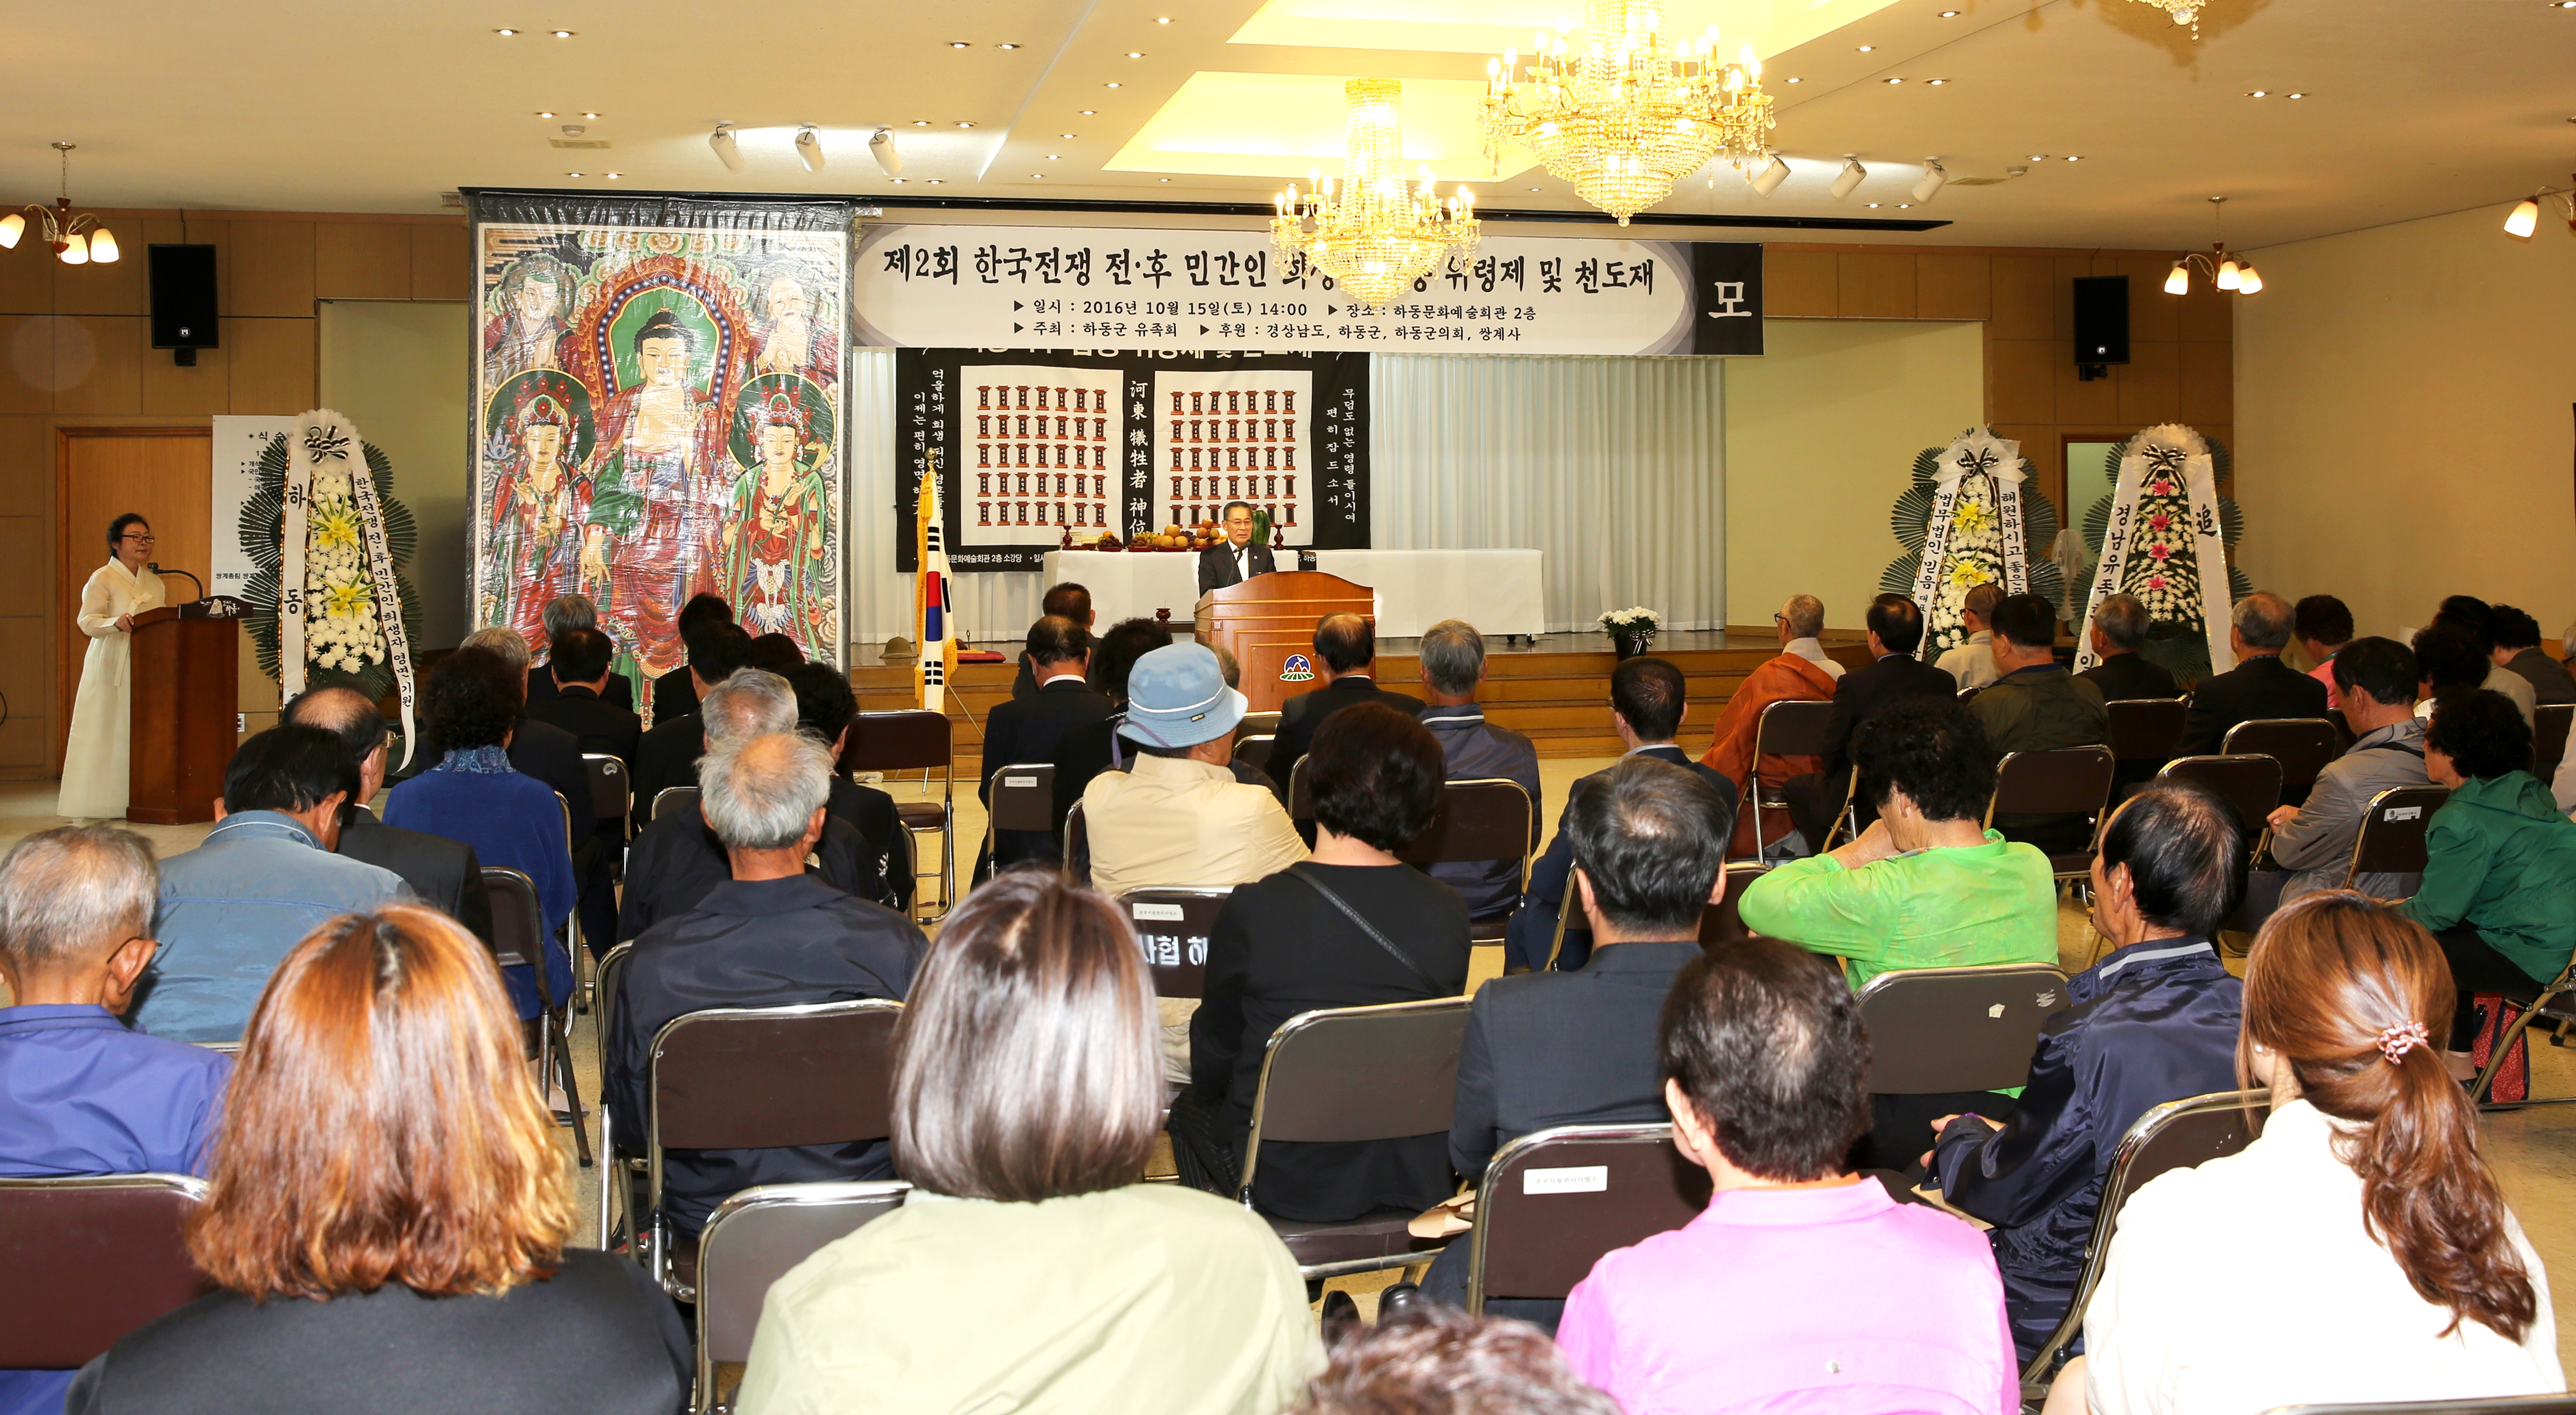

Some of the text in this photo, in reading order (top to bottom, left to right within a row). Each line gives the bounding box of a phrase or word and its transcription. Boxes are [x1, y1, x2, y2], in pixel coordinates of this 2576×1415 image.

[883, 244, 958, 285] 제2회
[974, 244, 1091, 286] 한국전쟁
[1105, 245, 1172, 289] 전·후
[1185, 250, 1267, 287] 민간인
[1445, 255, 1524, 293] 위령제
[1539, 256, 1562, 293] 및
[1575, 258, 1654, 295] 천도재
[1034, 299, 1061, 314] 일시
[1083, 300, 1137, 316] 2016년
[1146, 301, 1179, 316] 10월
[1188, 302, 1252, 316] 15일(토)
[1260, 303, 1307, 316] 14:00
[1347, 303, 1374, 318] 장소
[1393, 304, 1507, 320] 하동문화예술회관
[1514, 306, 1537, 321] 2층
[1708, 281, 1752, 318] 모
[1033, 321, 1060, 336] 주최
[1083, 322, 1127, 337] 하동군
[1134, 322, 1177, 337] 유족회
[1218, 323, 1246, 338] 후원
[1267, 323, 1331, 339] 경상남도,
[1338, 324, 1387, 340] 하동군,
[1395, 325, 1472, 341] 하동군의회,
[1479, 326, 1521, 342] 쌍계사
[931, 368, 945, 414] 억울하게
[1129, 380, 1148, 420] 河東
[1342, 389, 1355, 421] 무덤도
[913, 391, 927, 425] 이제는
[913, 430, 925, 453] 편히
[932, 419, 944, 442] 희생
[1343, 427, 1355, 448] 없는
[1928, 493, 1953, 554] 법무법인
[2001, 491, 2023, 556] 해원하시고
[991, 554, 1002, 563] 2층
[1003, 553, 1023, 563] 소강당
[2007, 561, 2025, 586] 좋은
[375, 567, 394, 606] 민간인
[383, 610, 405, 648] 희생자
